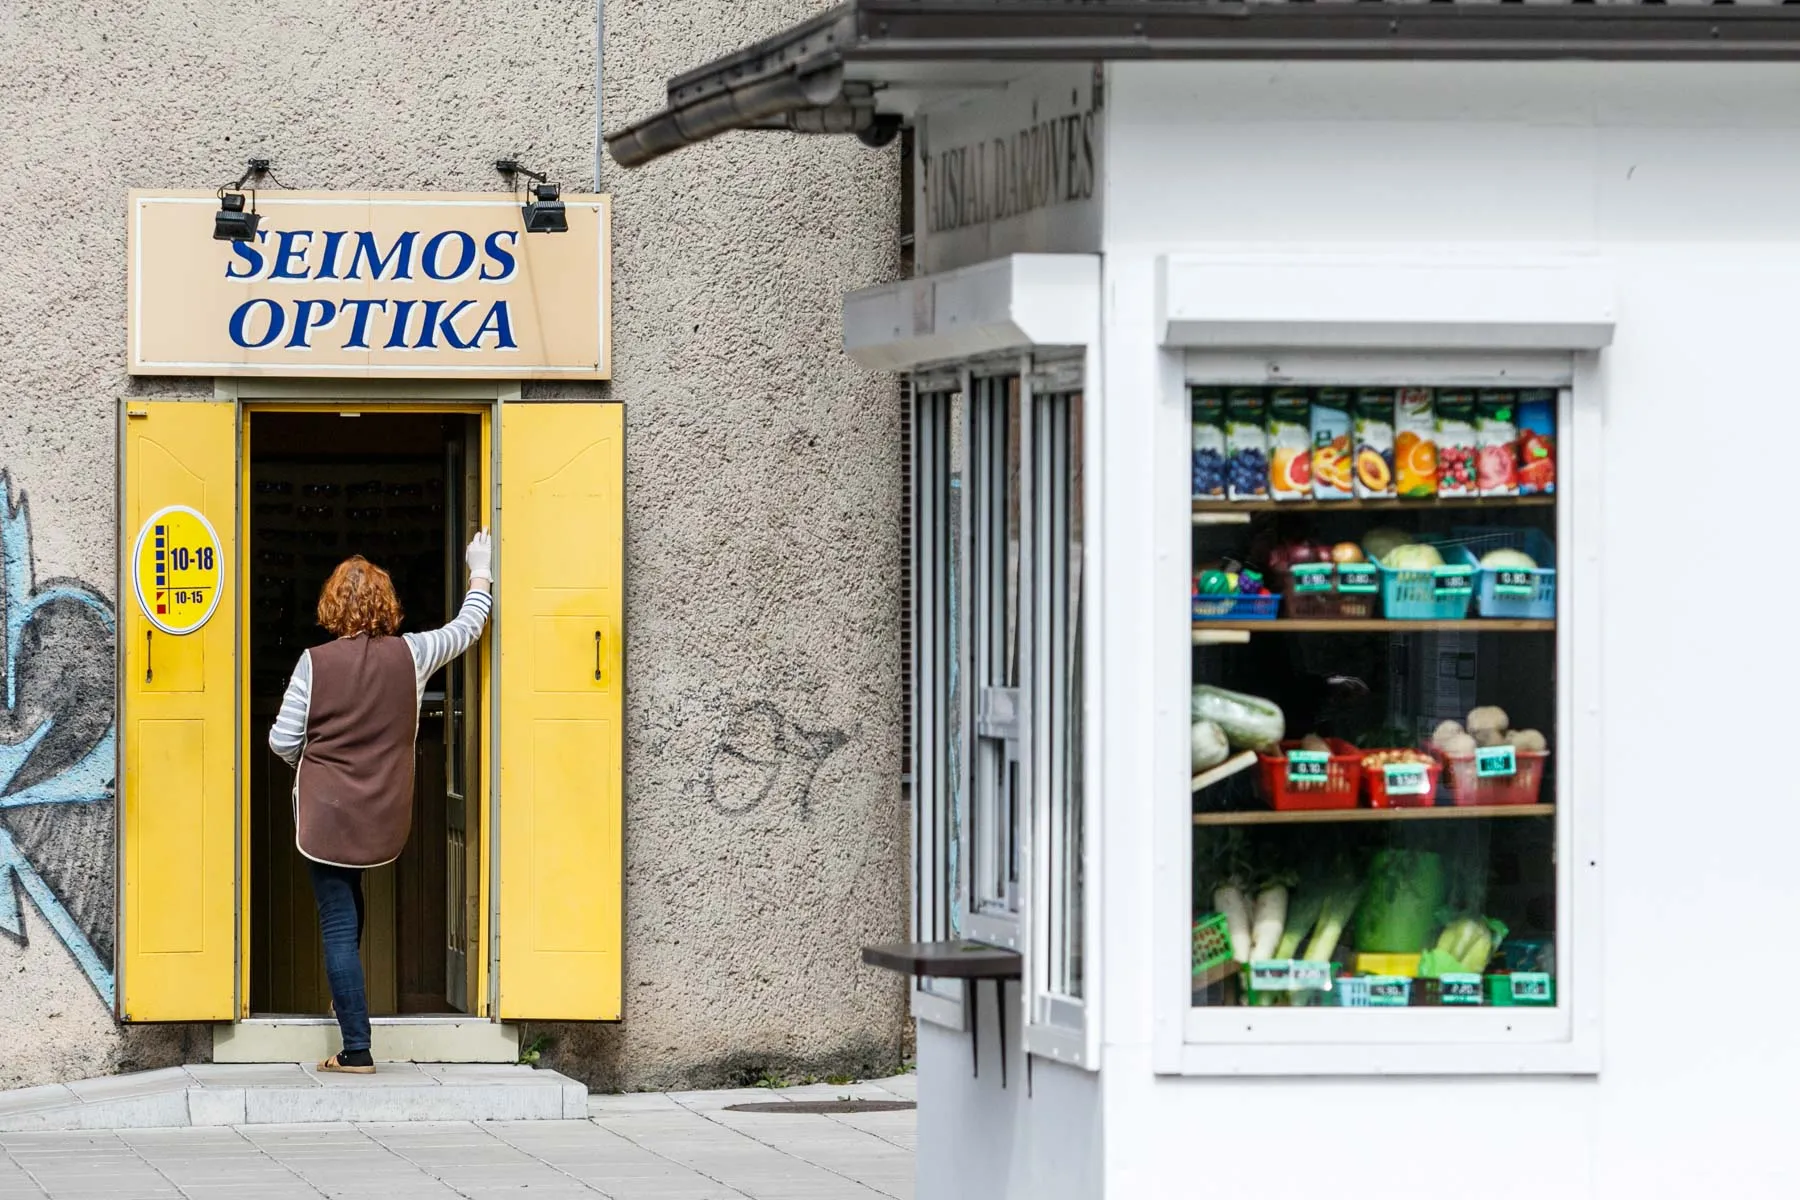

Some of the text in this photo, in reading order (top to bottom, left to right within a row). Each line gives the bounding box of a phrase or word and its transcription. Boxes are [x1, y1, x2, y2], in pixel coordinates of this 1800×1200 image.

[228, 298, 519, 350] OPTIKA
[170, 546, 214, 571] 10-18
[174, 590, 203, 604] 10-15
